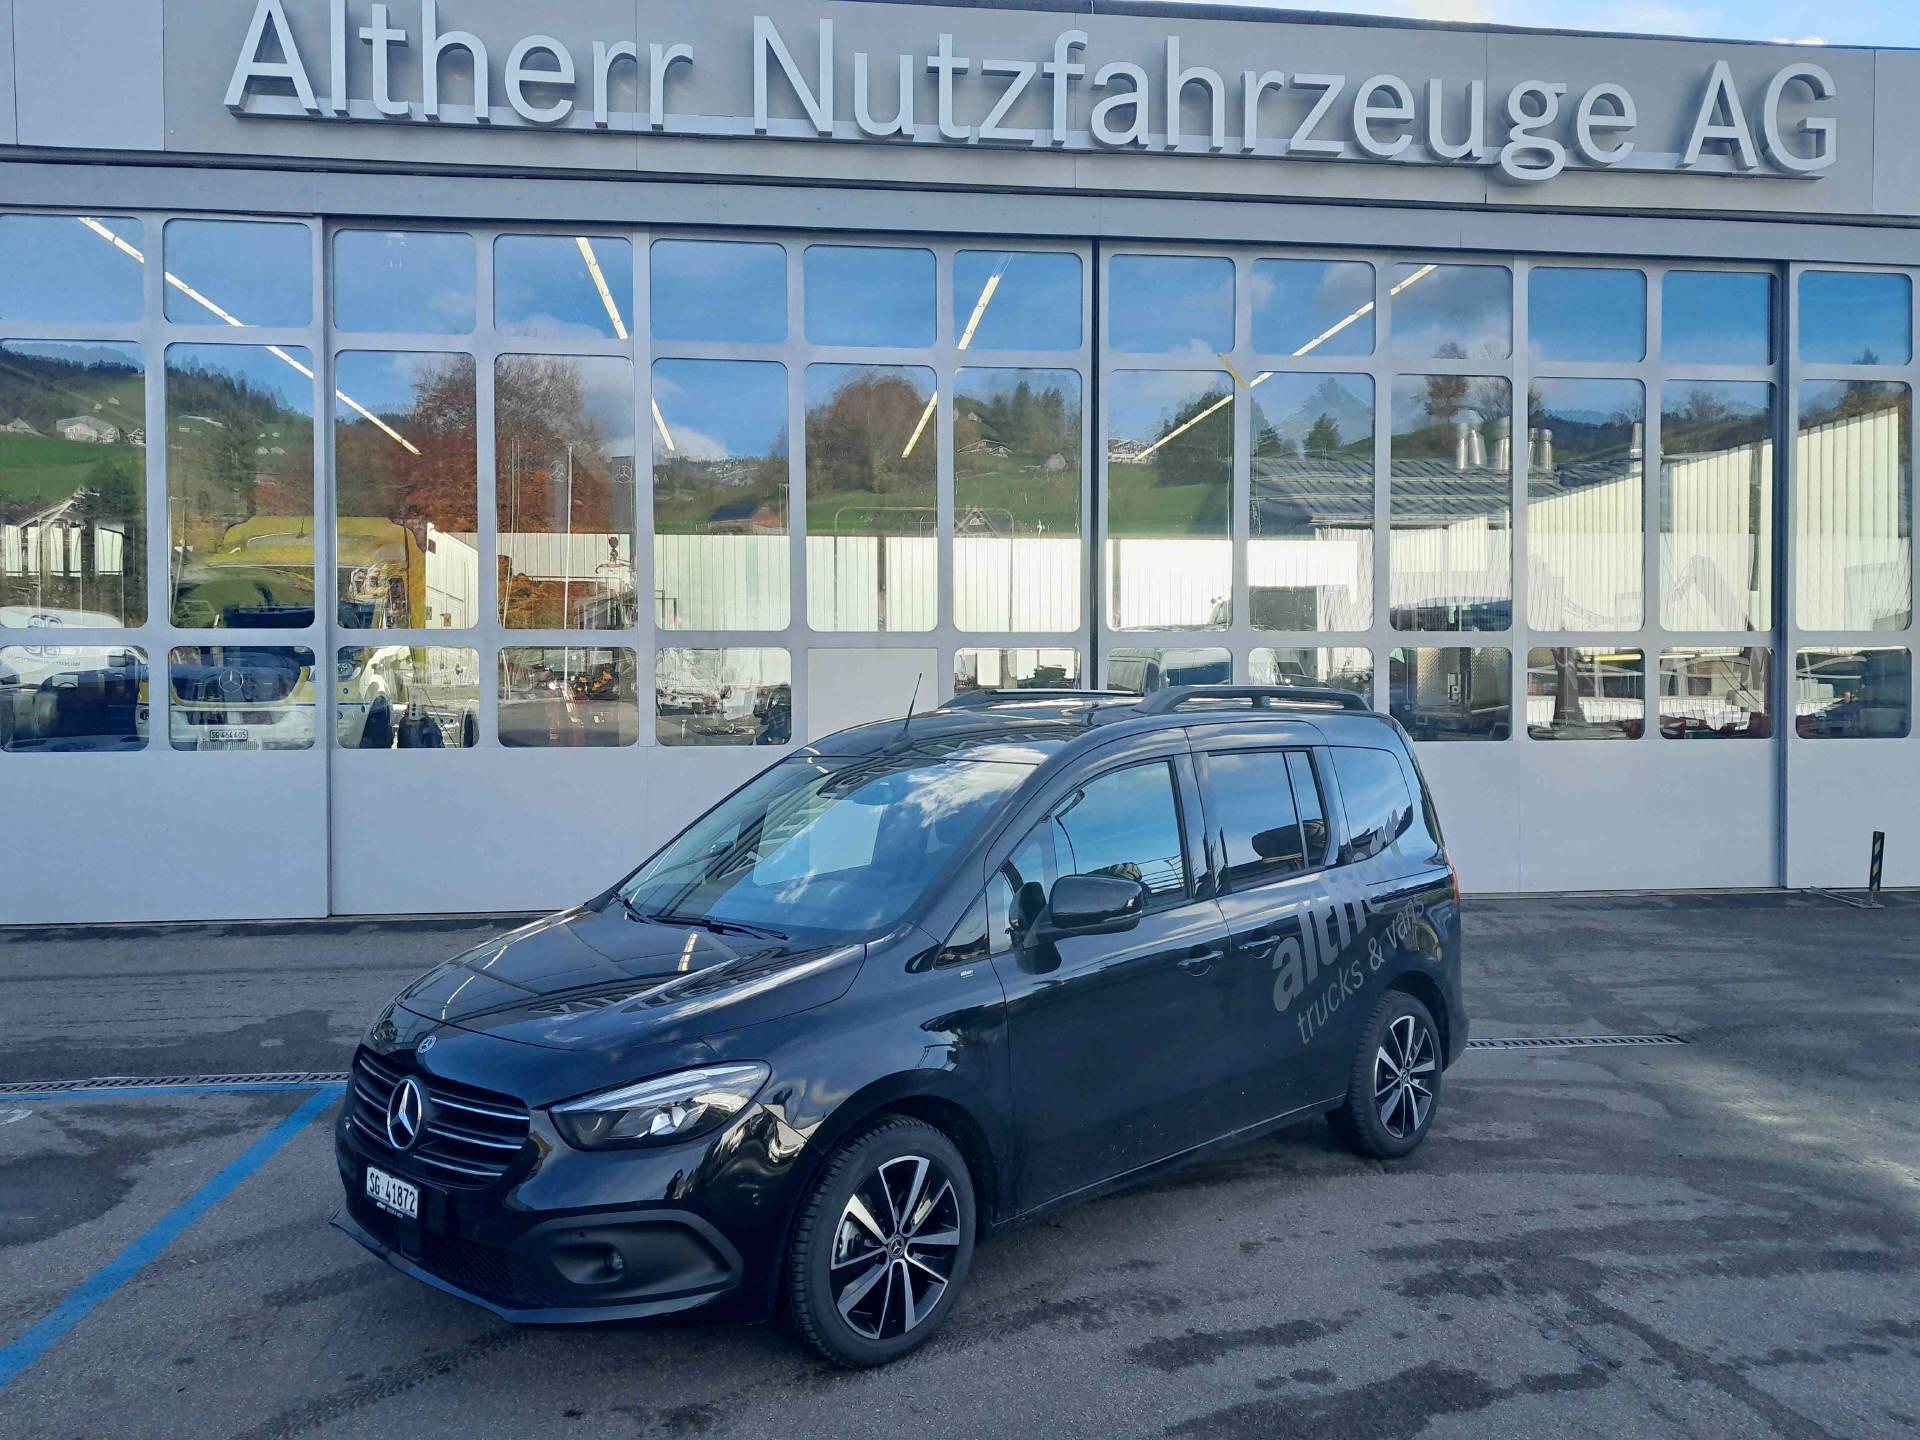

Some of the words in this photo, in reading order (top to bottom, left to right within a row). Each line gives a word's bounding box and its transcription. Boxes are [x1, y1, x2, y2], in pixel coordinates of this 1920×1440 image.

[224, 0, 694, 130] Altherr
[752, 15, 1638, 187] Nutzfahrzeuge
[1678, 59, 1838, 175] AG
[1297, 961, 1364, 1045] trucks
[1367, 937, 1386, 971] &
[369, 1172, 380, 1196] SG
[386, 1180, 416, 1213] 41872
